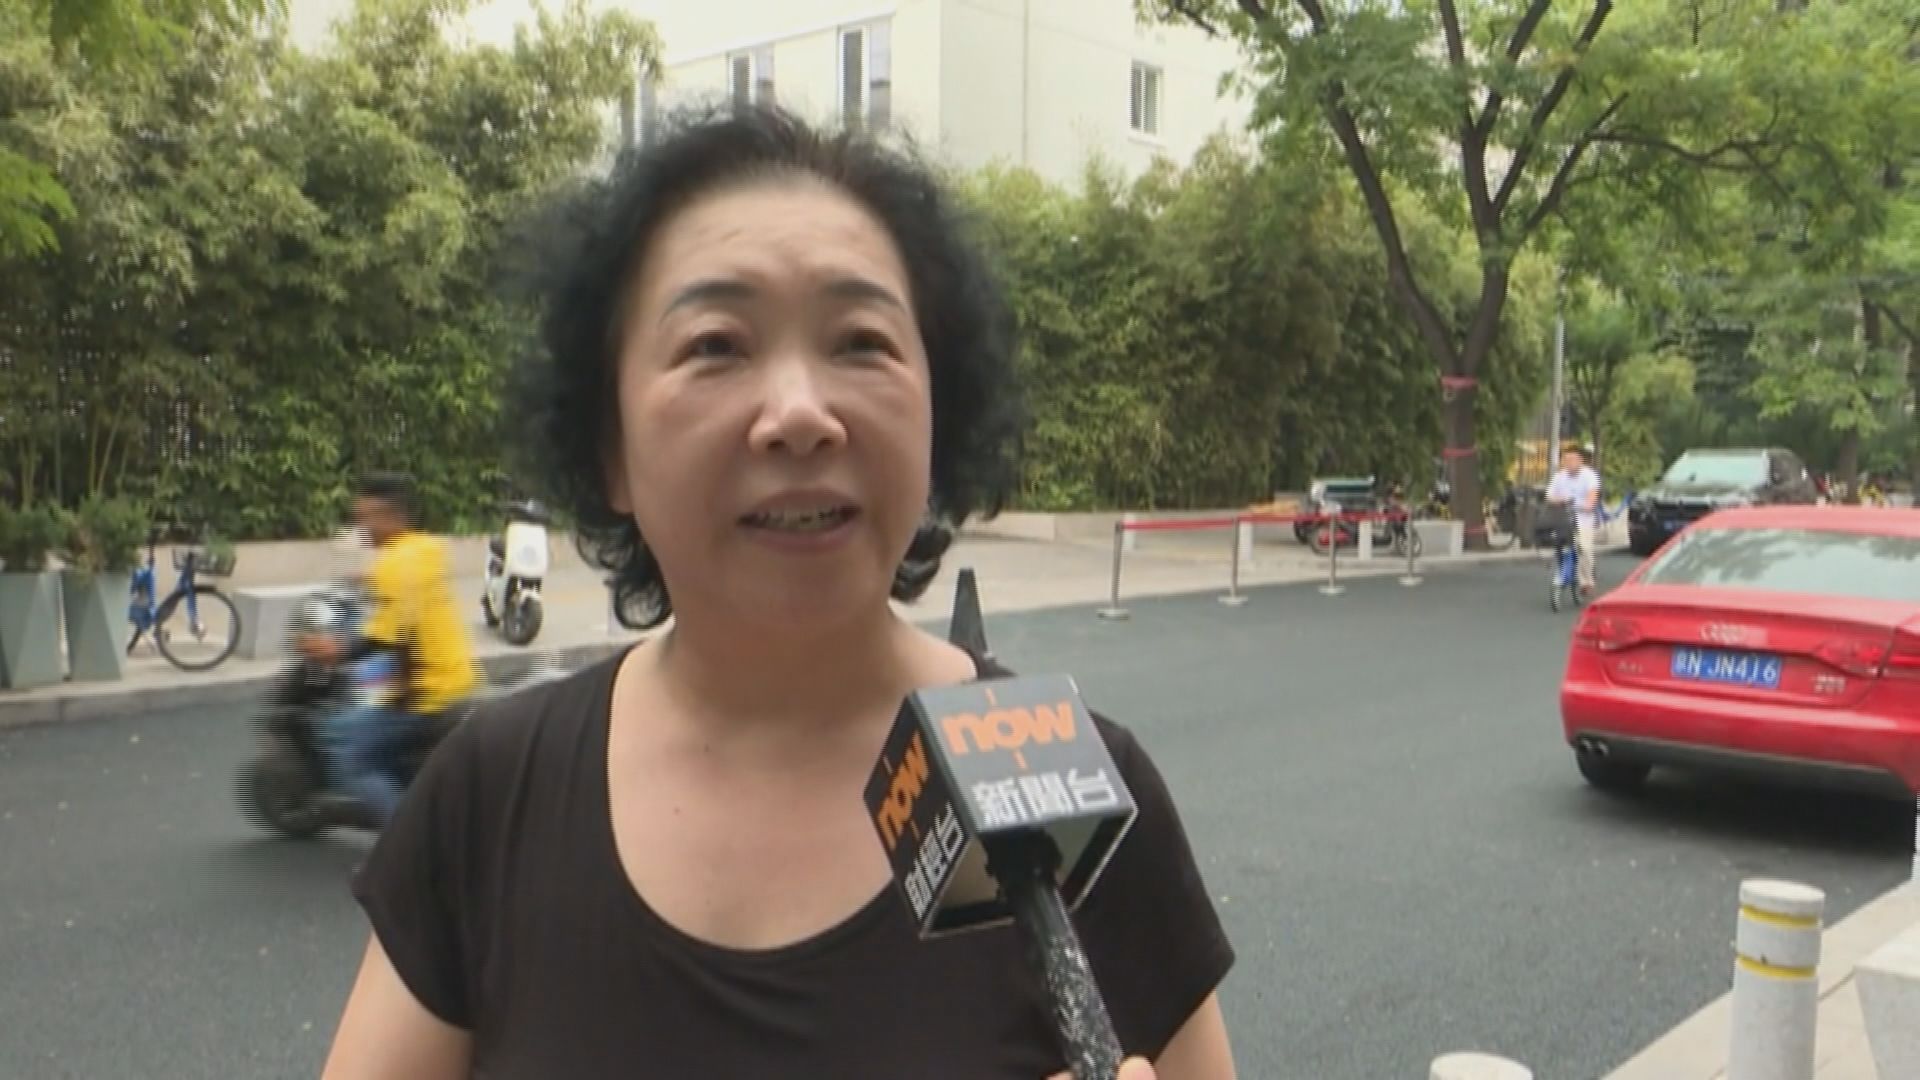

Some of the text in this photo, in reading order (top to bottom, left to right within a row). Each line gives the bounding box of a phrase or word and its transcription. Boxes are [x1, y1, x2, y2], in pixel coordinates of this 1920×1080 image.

[941, 699, 1077, 755] now
[877, 730, 930, 851] now
[971, 767, 1120, 828] 新聞台
